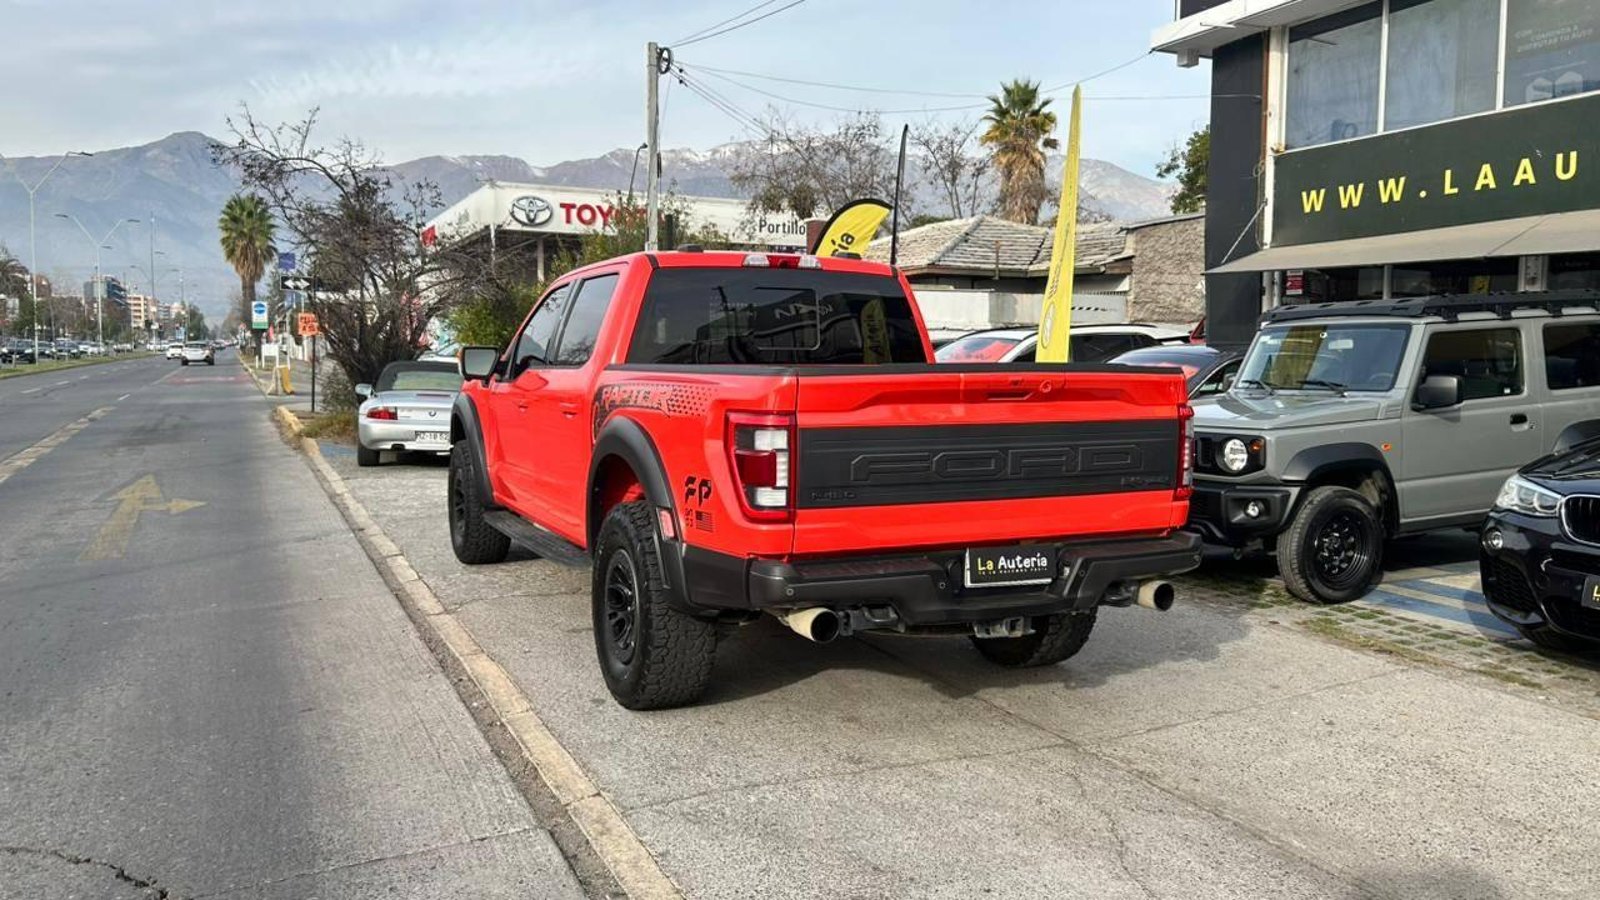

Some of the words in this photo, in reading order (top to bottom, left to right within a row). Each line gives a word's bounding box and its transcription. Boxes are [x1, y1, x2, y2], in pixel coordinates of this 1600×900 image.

[559, 202, 666, 230] TOYO
[758, 218, 806, 236] Portillo
[850, 443, 1145, 483] FORD
[977, 556, 994, 571] La
[998, 552, 1048, 570] Autería
